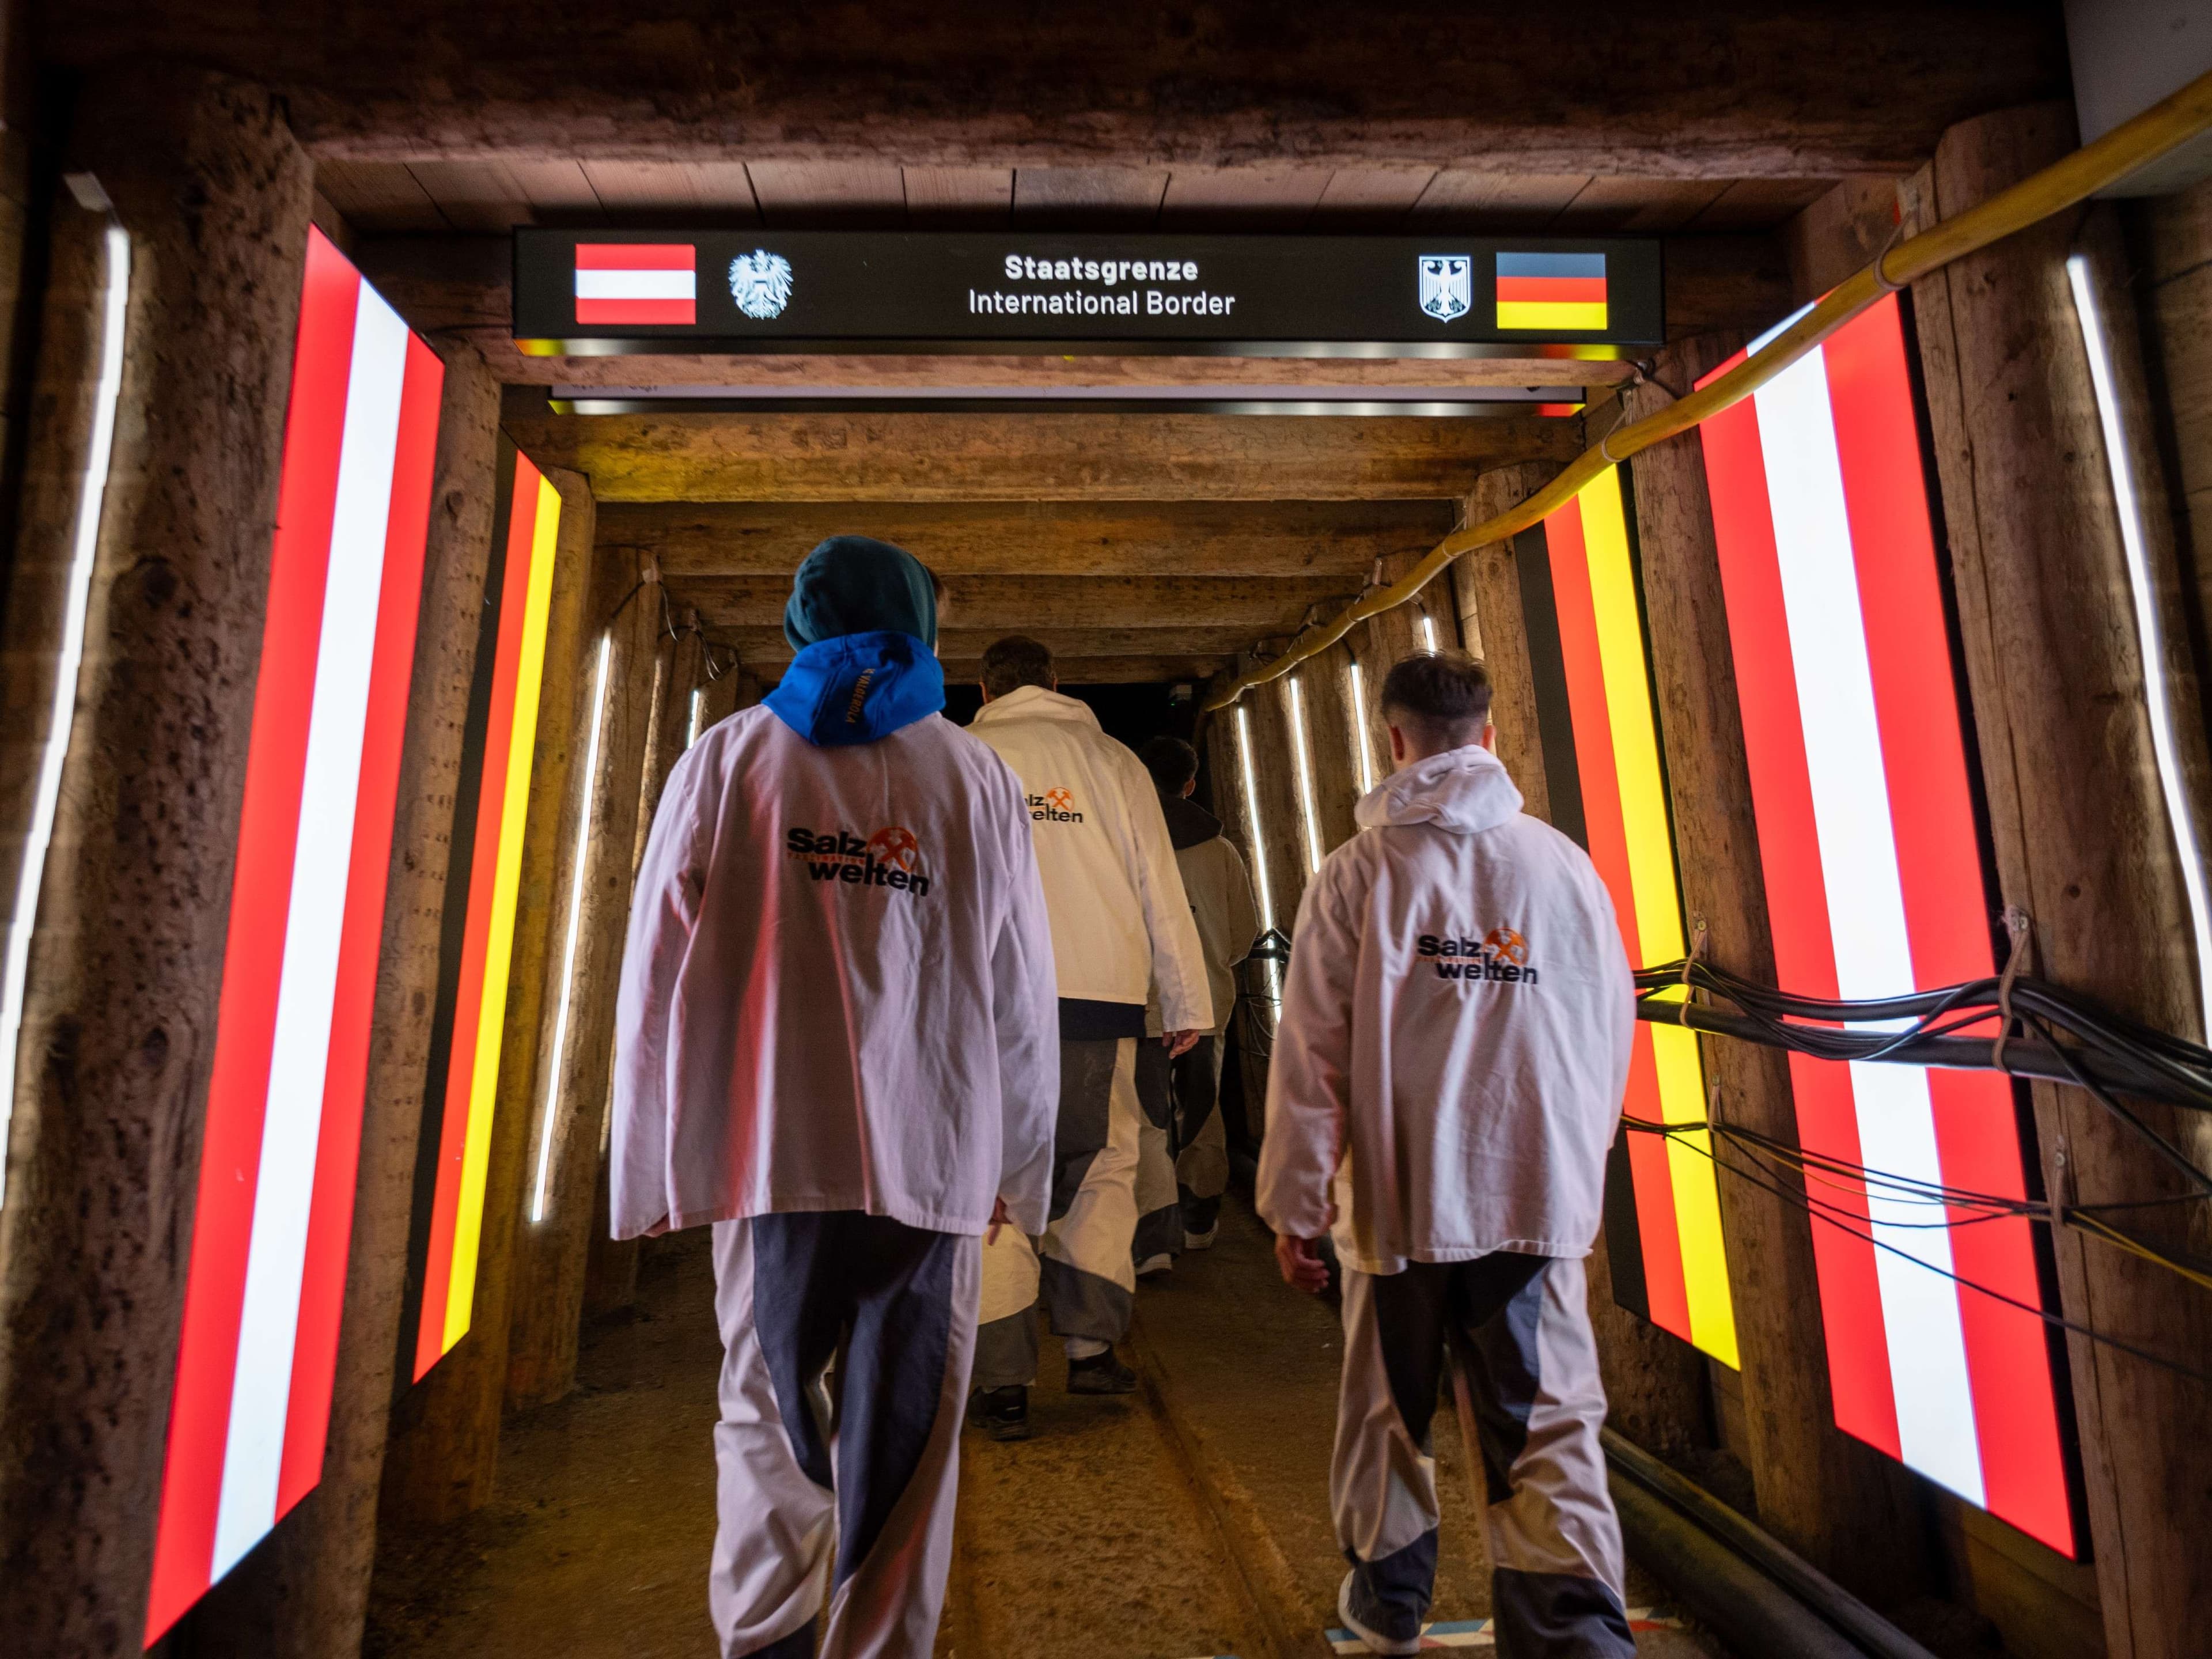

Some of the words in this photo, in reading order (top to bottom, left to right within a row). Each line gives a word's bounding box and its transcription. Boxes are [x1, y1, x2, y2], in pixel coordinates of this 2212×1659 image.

[1005, 255, 1198, 285] Staatsgrenze
[969, 289, 1138, 315] International
[1146, 290, 1236, 315] Border
[1031, 804, 1083, 823] elten
[787, 827, 867, 858] Salz
[808, 853, 929, 897] welten
[1418, 935, 1482, 957] Salz
[1436, 952, 1538, 984] welten
